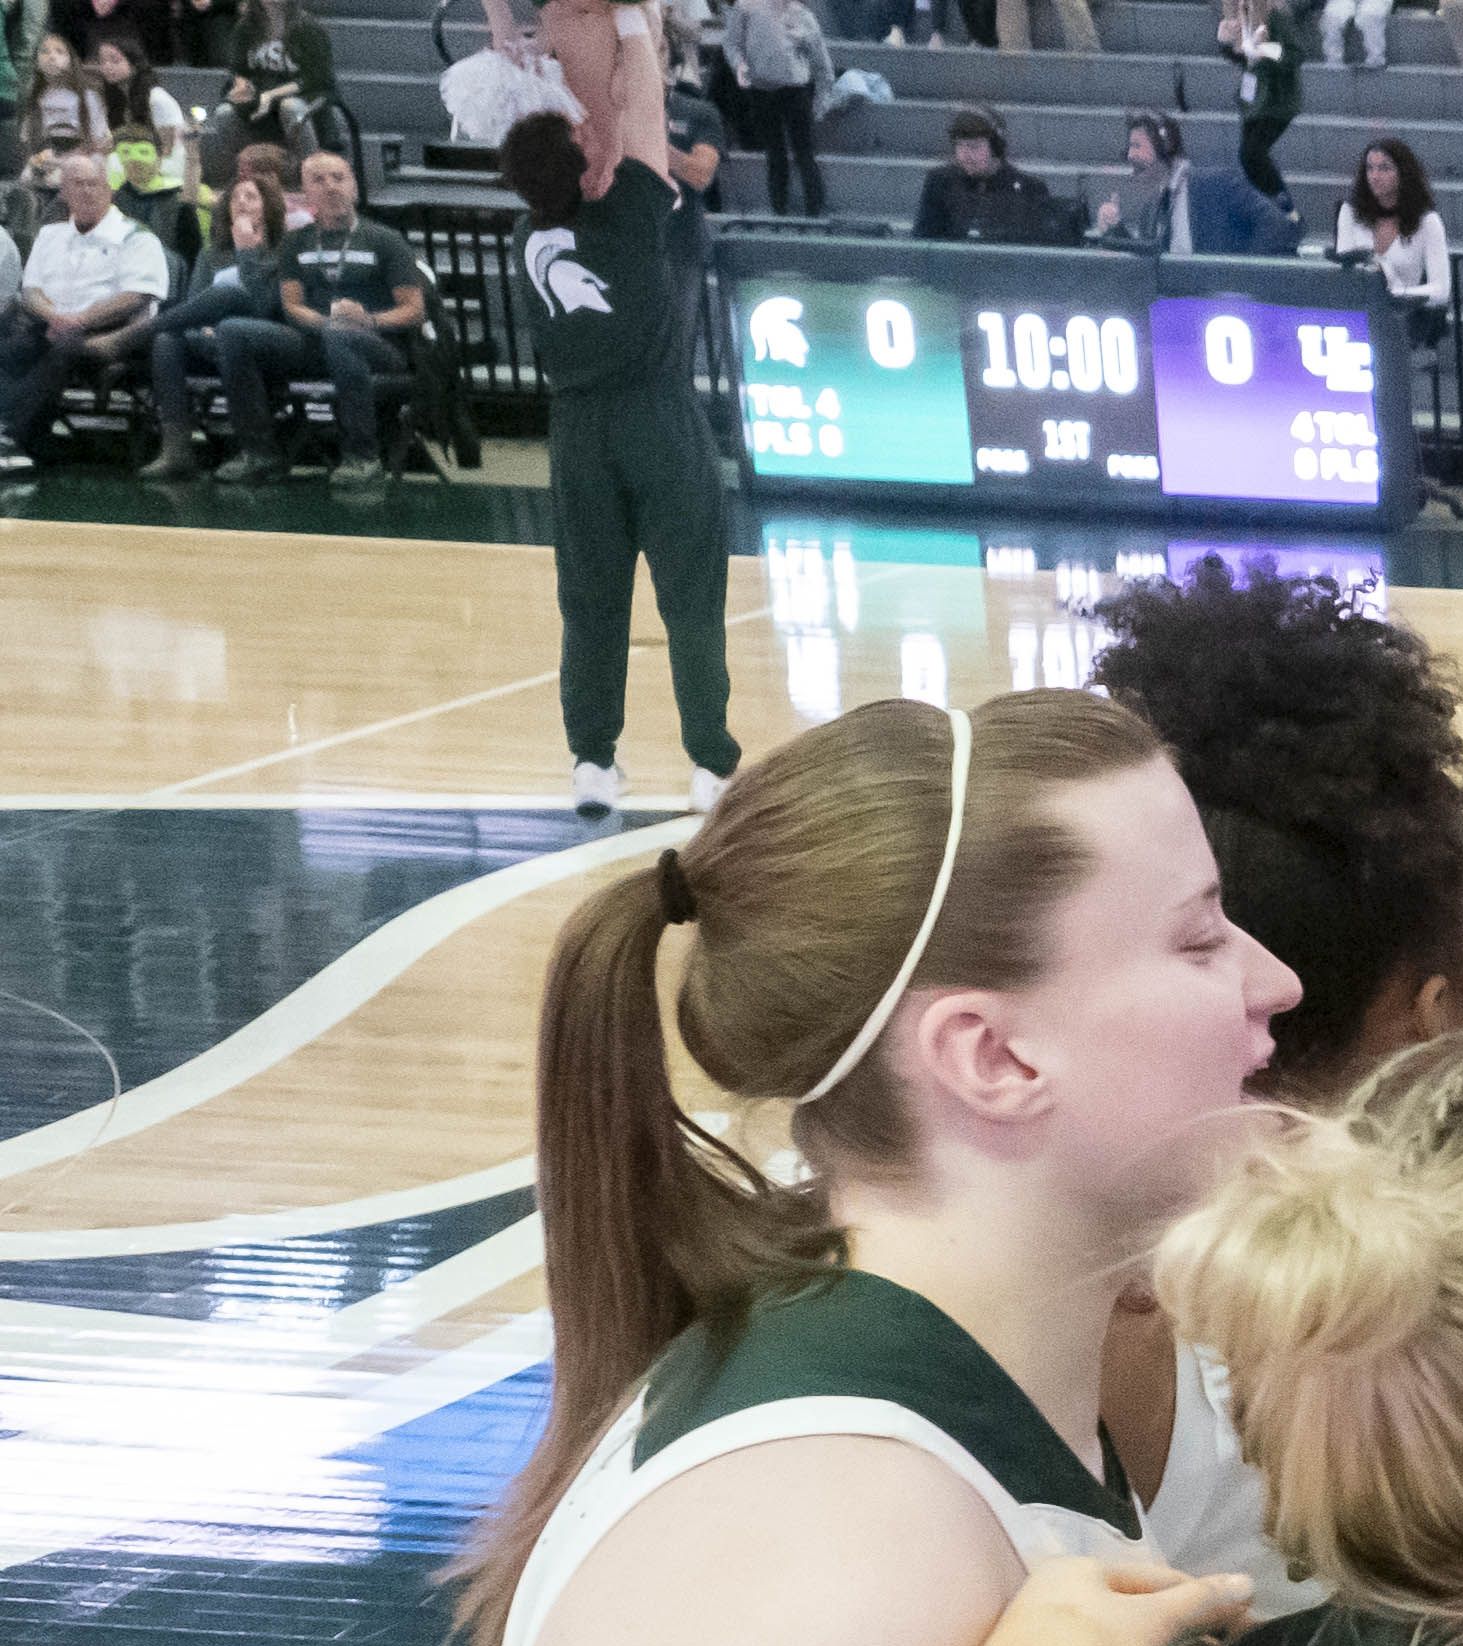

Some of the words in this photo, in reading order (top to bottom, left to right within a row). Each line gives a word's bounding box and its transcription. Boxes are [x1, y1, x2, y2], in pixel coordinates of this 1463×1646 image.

[866, 299, 915, 368] 0
[977, 312, 1139, 394] 10:00
[1204, 315, 1254, 385] 0
